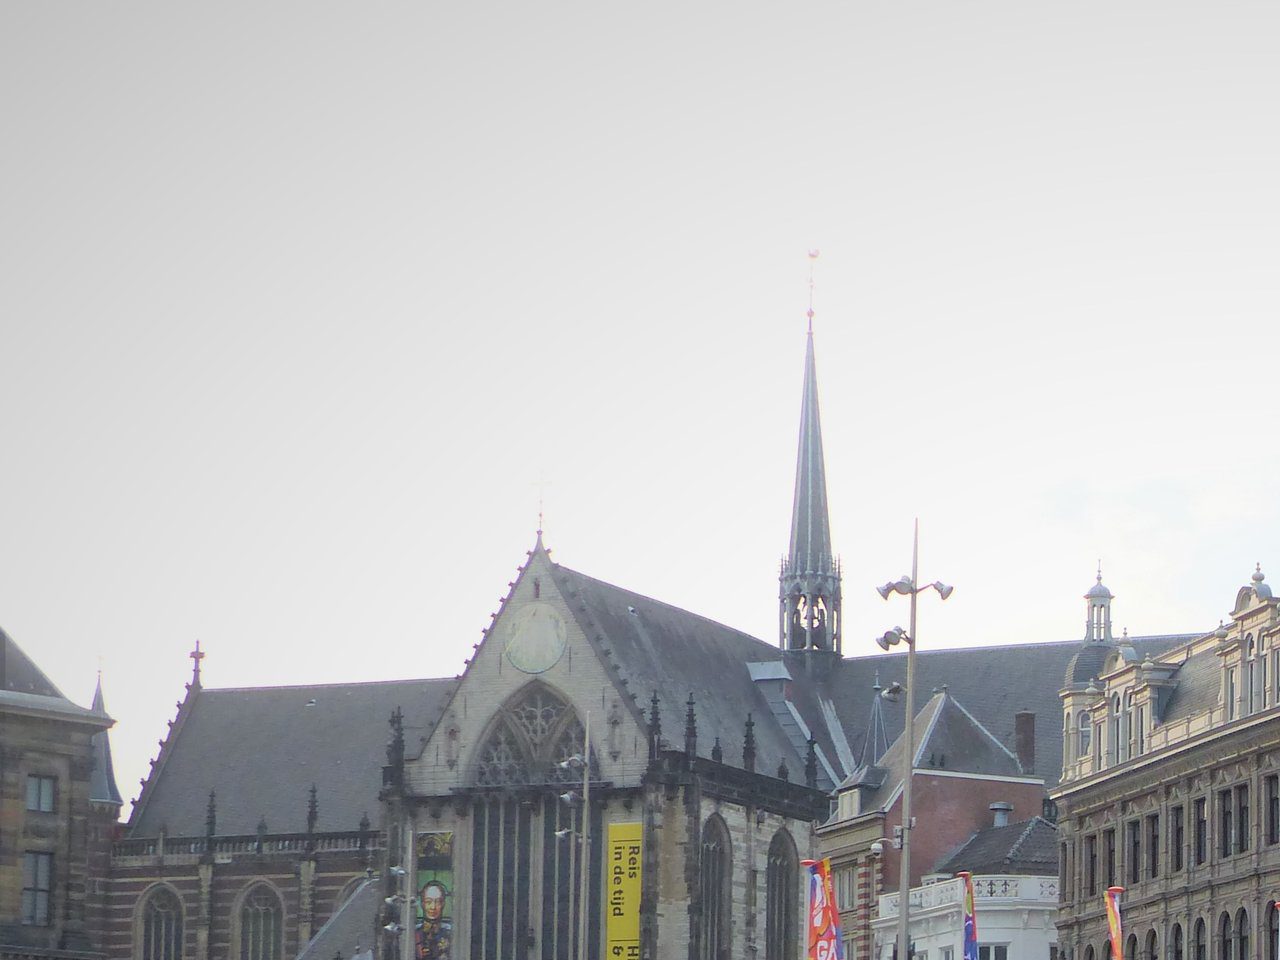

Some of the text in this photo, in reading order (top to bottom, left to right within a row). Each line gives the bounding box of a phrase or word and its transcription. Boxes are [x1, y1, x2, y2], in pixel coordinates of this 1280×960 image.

[628, 845, 640, 879] Reis
[610, 846, 625, 917] in de tijd
[612, 946, 624, 957] &
